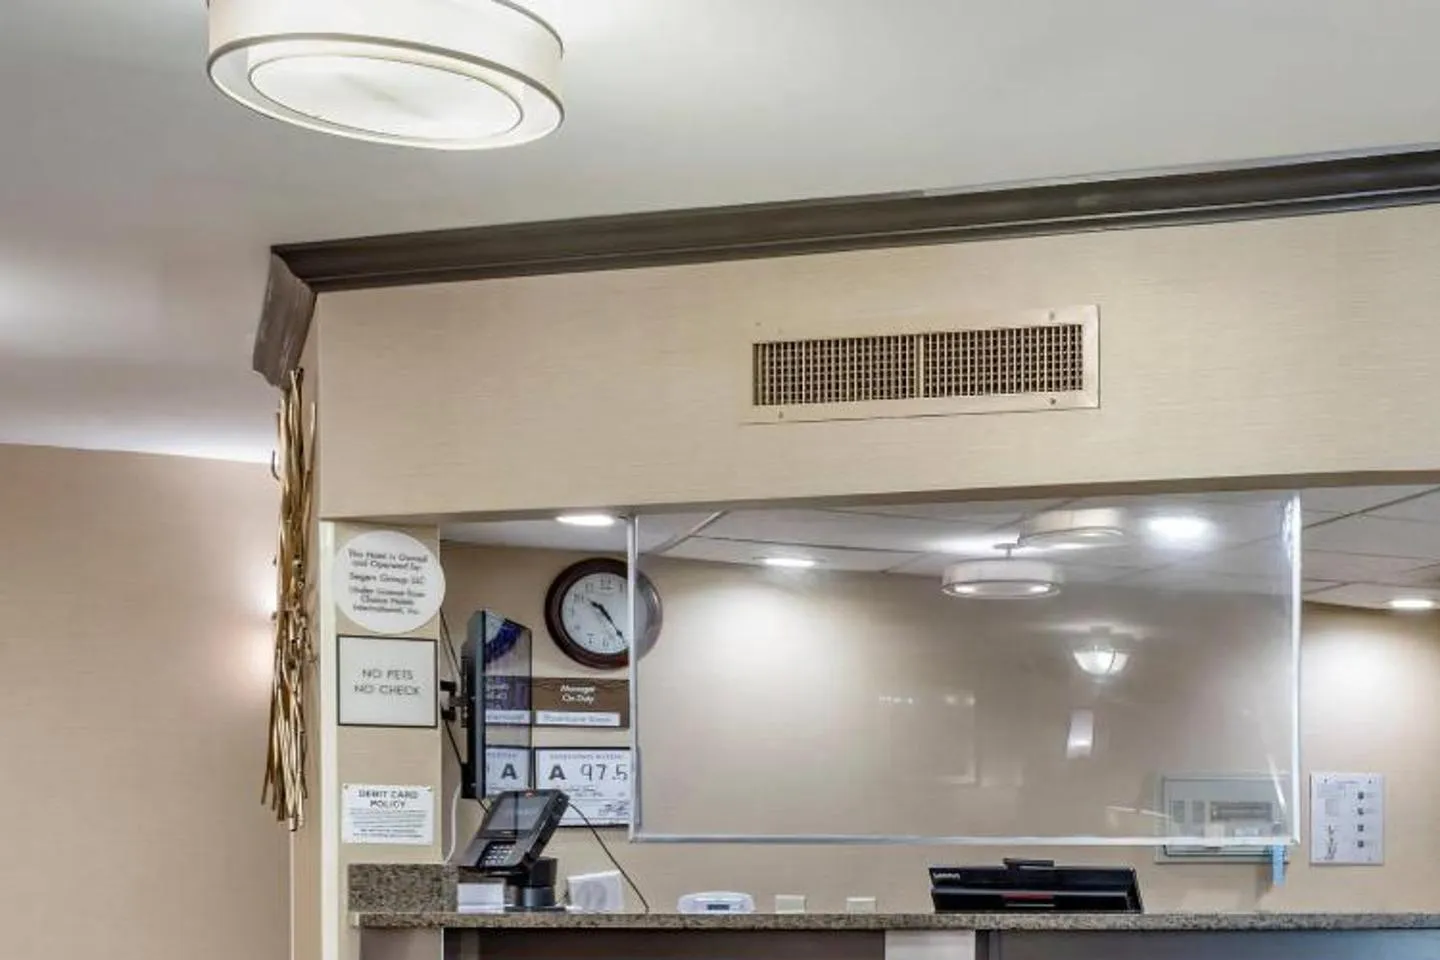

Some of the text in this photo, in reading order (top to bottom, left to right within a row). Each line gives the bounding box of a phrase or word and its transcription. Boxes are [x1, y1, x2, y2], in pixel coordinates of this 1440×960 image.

[362, 668, 413, 681] NO PETS
[354, 684, 421, 696] NO CHECK
[549, 763, 567, 781] A
